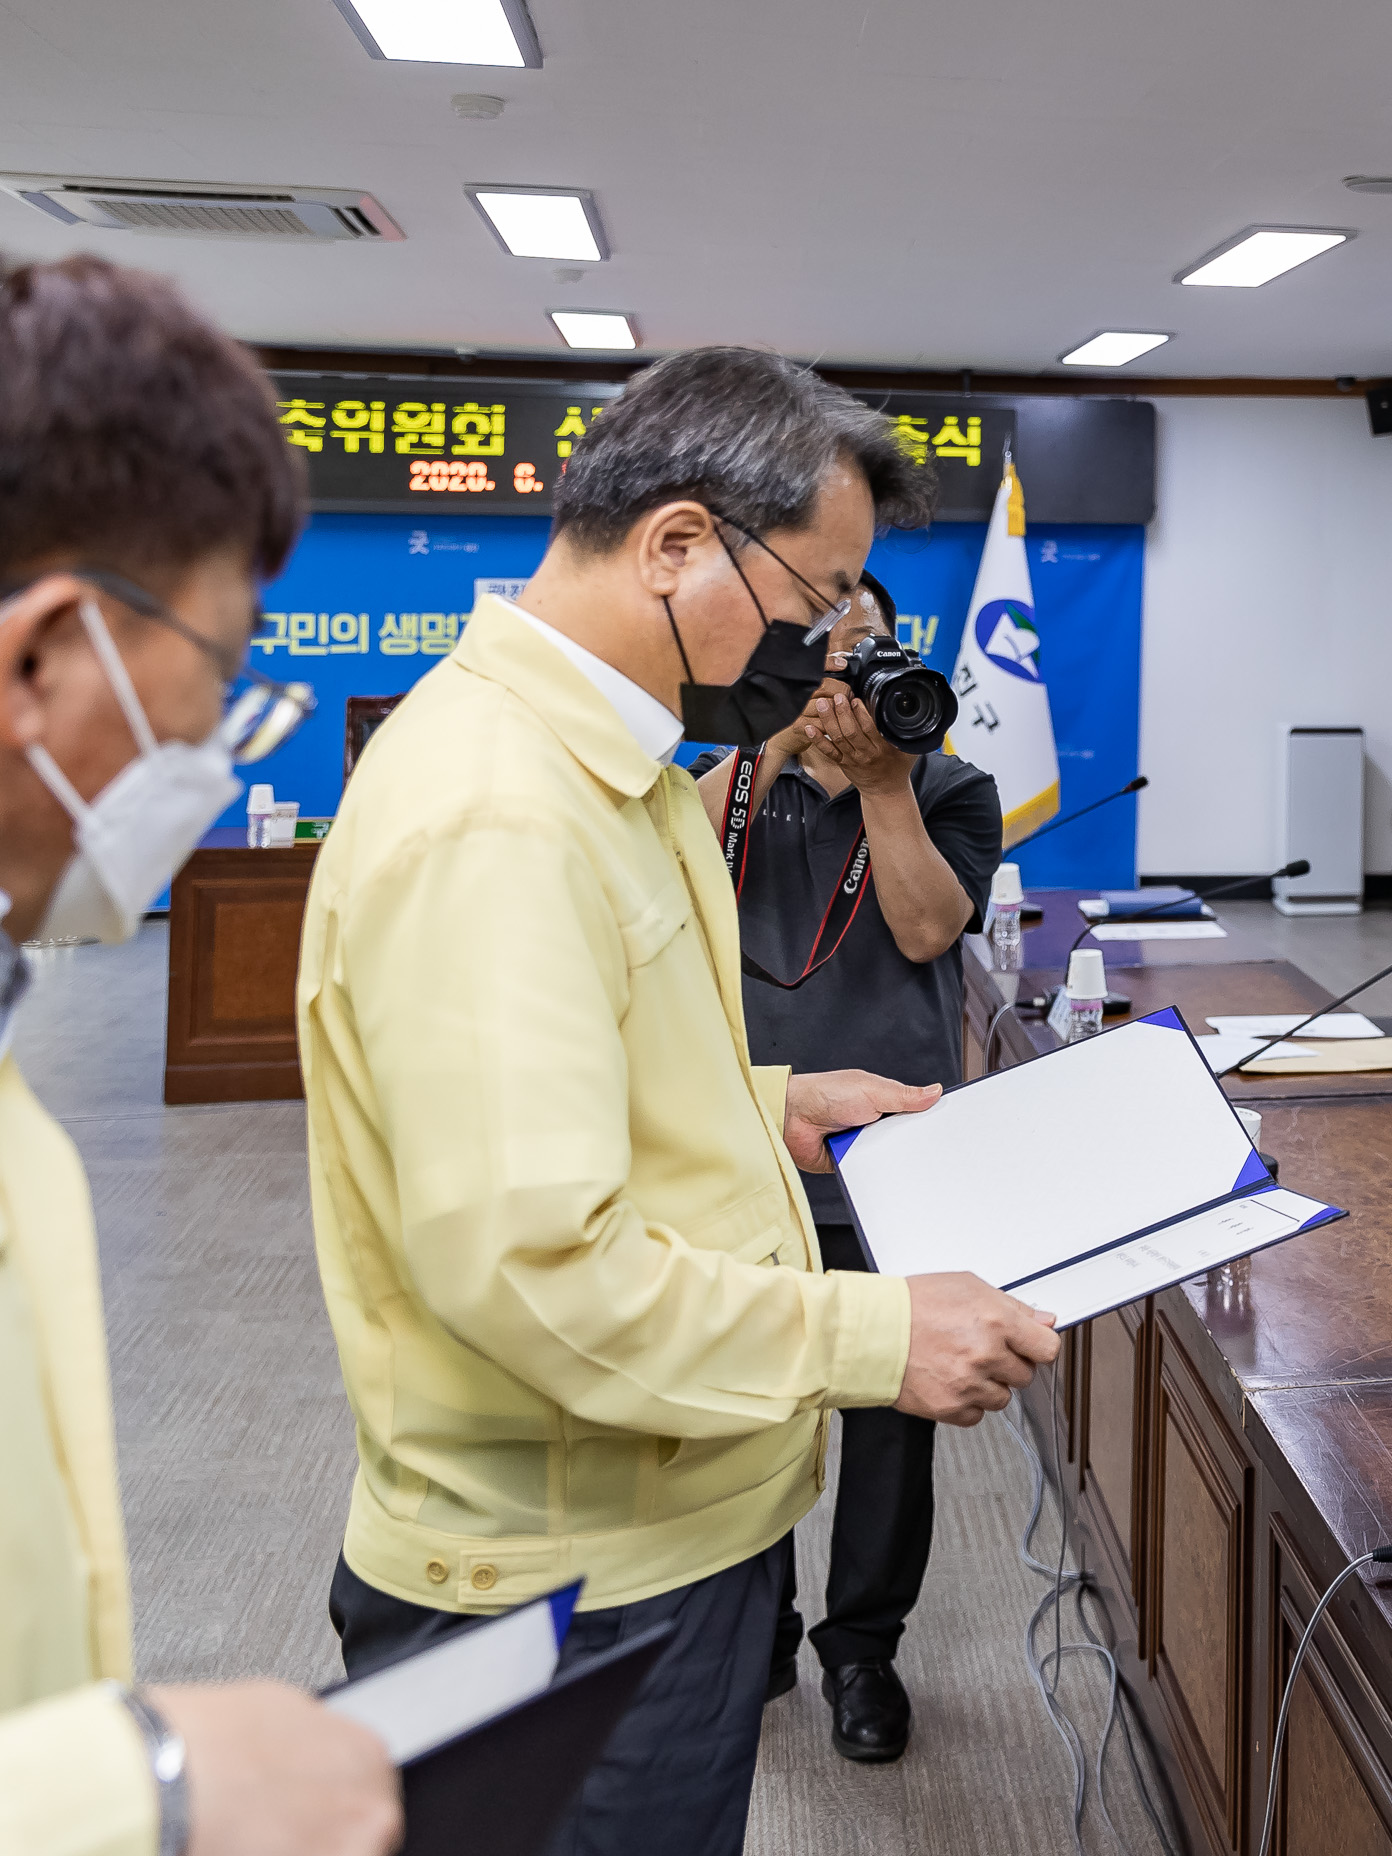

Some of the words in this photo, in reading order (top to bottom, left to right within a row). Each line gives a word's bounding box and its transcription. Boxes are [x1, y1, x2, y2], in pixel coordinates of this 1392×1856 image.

[409, 460, 496, 492] 2020.
[249, 613, 370, 656] 구민의
[378, 613, 472, 655] 생명
[734, 760, 753, 804] EOS
[730, 807, 747, 829] 5D
[725, 832, 738, 860] Mark
[843, 836, 869, 894] Canon
